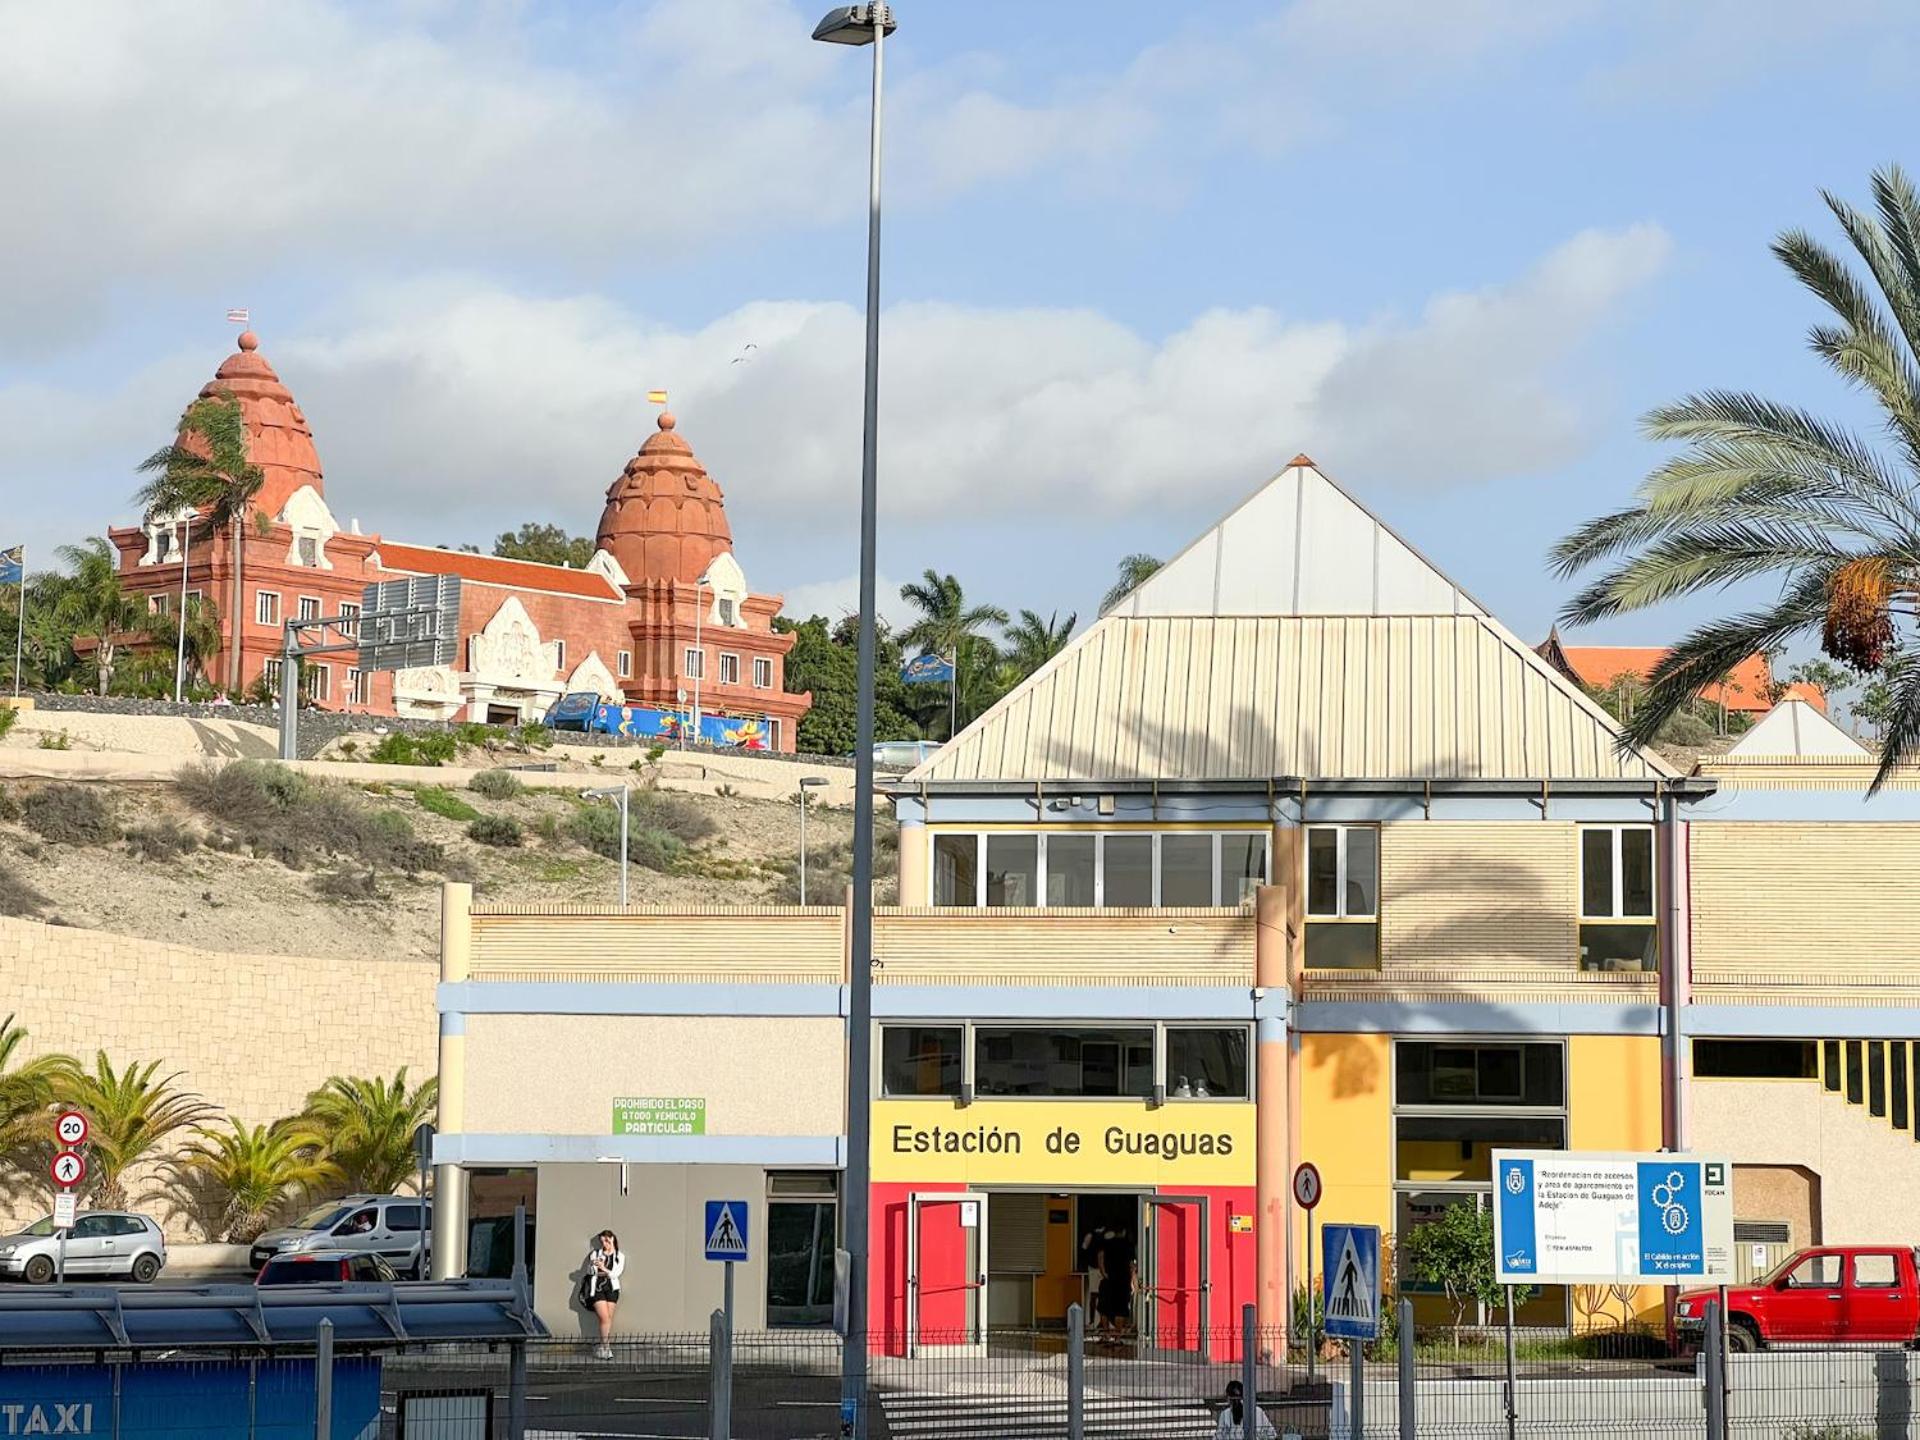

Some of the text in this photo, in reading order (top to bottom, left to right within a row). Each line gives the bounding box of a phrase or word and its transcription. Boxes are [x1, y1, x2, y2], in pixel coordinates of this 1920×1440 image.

[614, 1098, 704, 1109] PROHIBIDO EL PASO
[64, 1124, 80, 1134] 20
[625, 1122, 692, 1133] PARTICULAR
[892, 1124, 1233, 1161] Estación de Guaguas
[1593, 1171, 1602, 1179] de
[1537, 1182, 1543, 1190] y
[1562, 1181, 1572, 1189] de
[1625, 1192, 1634, 1200] de
[1655, 1261, 1663, 1269] X
[2, 1403, 93, 1435] TAXI
